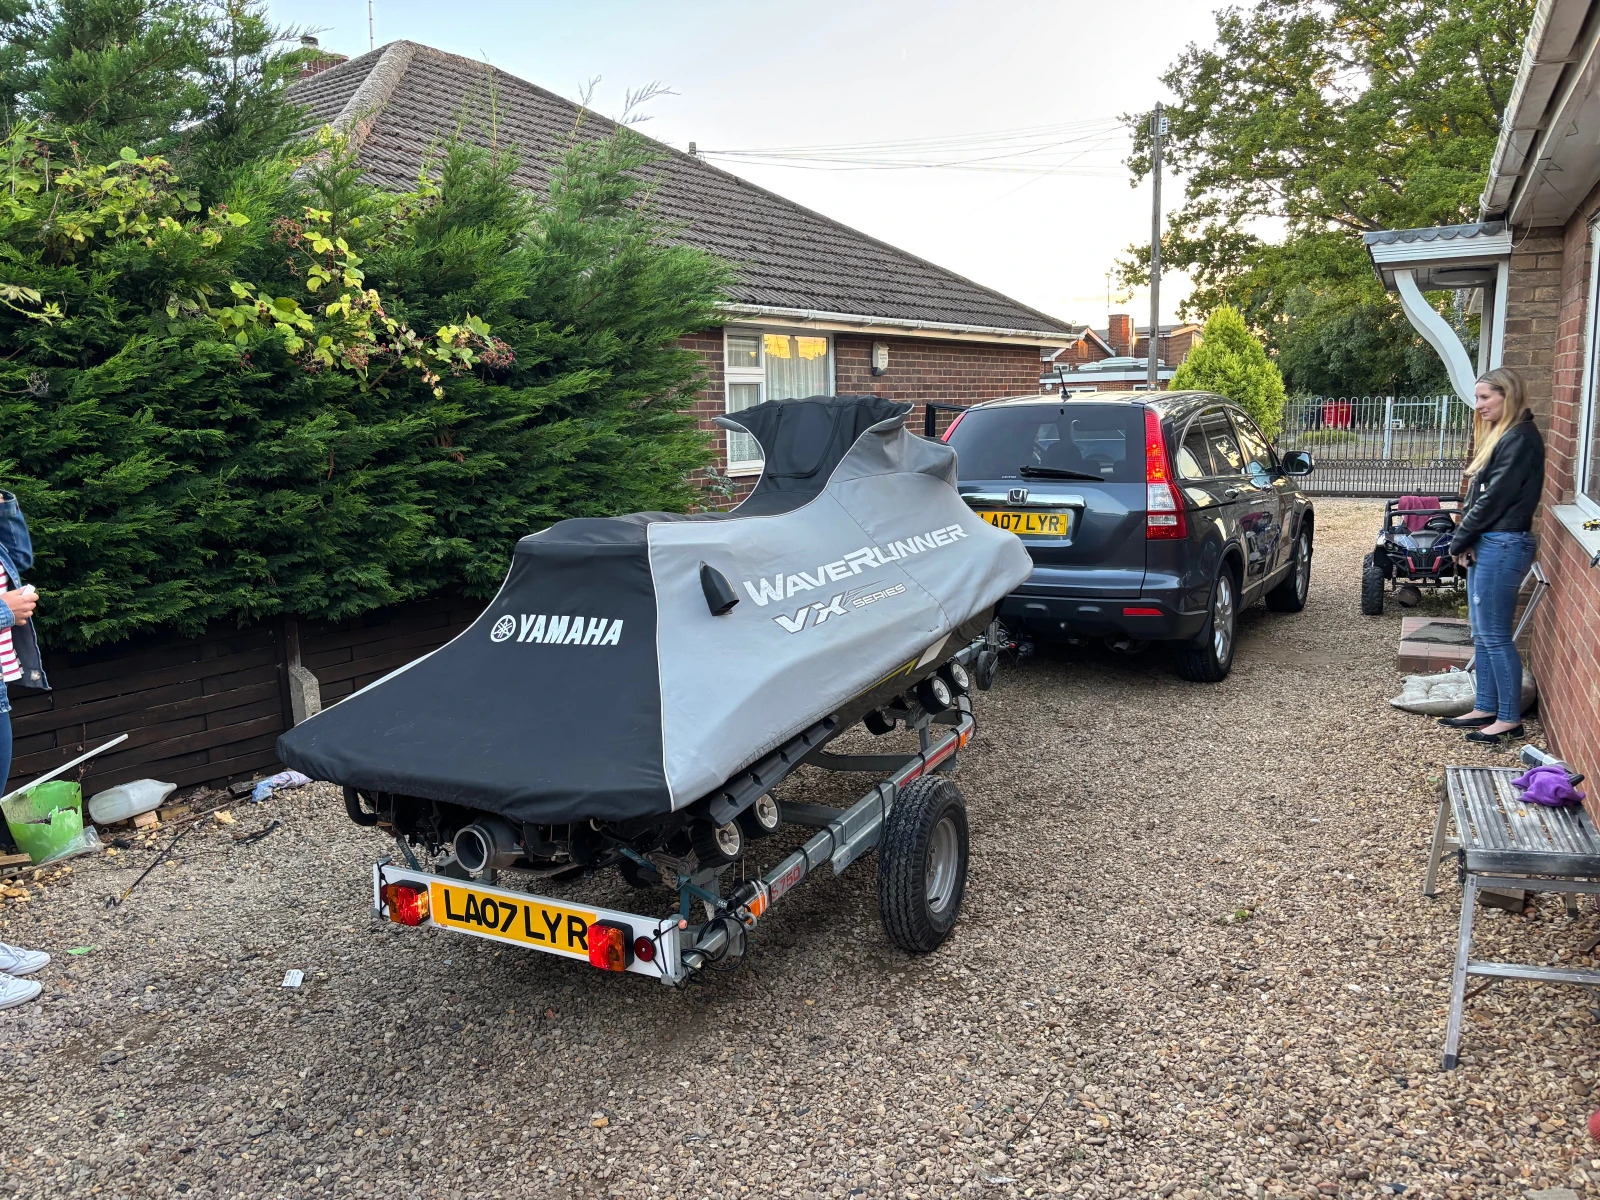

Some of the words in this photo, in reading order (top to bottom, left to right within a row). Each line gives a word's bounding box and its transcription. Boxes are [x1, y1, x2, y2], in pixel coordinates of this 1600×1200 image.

[1025, 515, 1060, 532] LYR
[743, 523, 969, 607] WAVERUNNER
[772, 588, 850, 634] VX
[852, 582, 907, 609] SERIES
[516, 614, 624, 646] YAMAHA
[779, 865, 801, 892] 750
[444, 889, 517, 933] LA07
[523, 905, 588, 951] LYR
